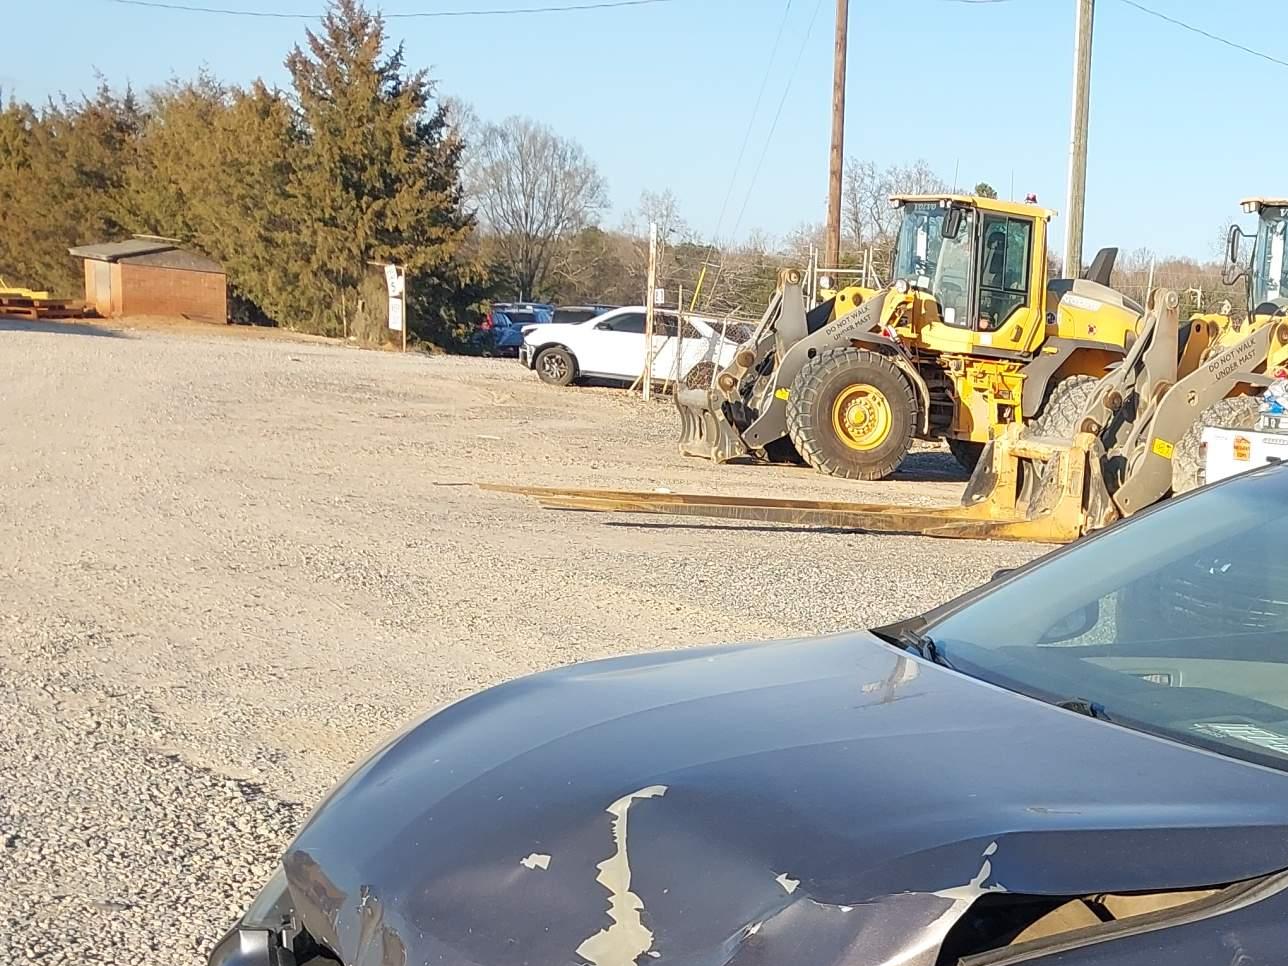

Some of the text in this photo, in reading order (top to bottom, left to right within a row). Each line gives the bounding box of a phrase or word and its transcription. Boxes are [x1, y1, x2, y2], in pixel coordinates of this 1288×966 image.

[825, 304, 869, 336] DO NOT WALK
[855, 314, 871, 328] MAST
[1209, 338, 1256, 372] DO NOT WALK
[1215, 349, 1256, 380] UNDER MAST
